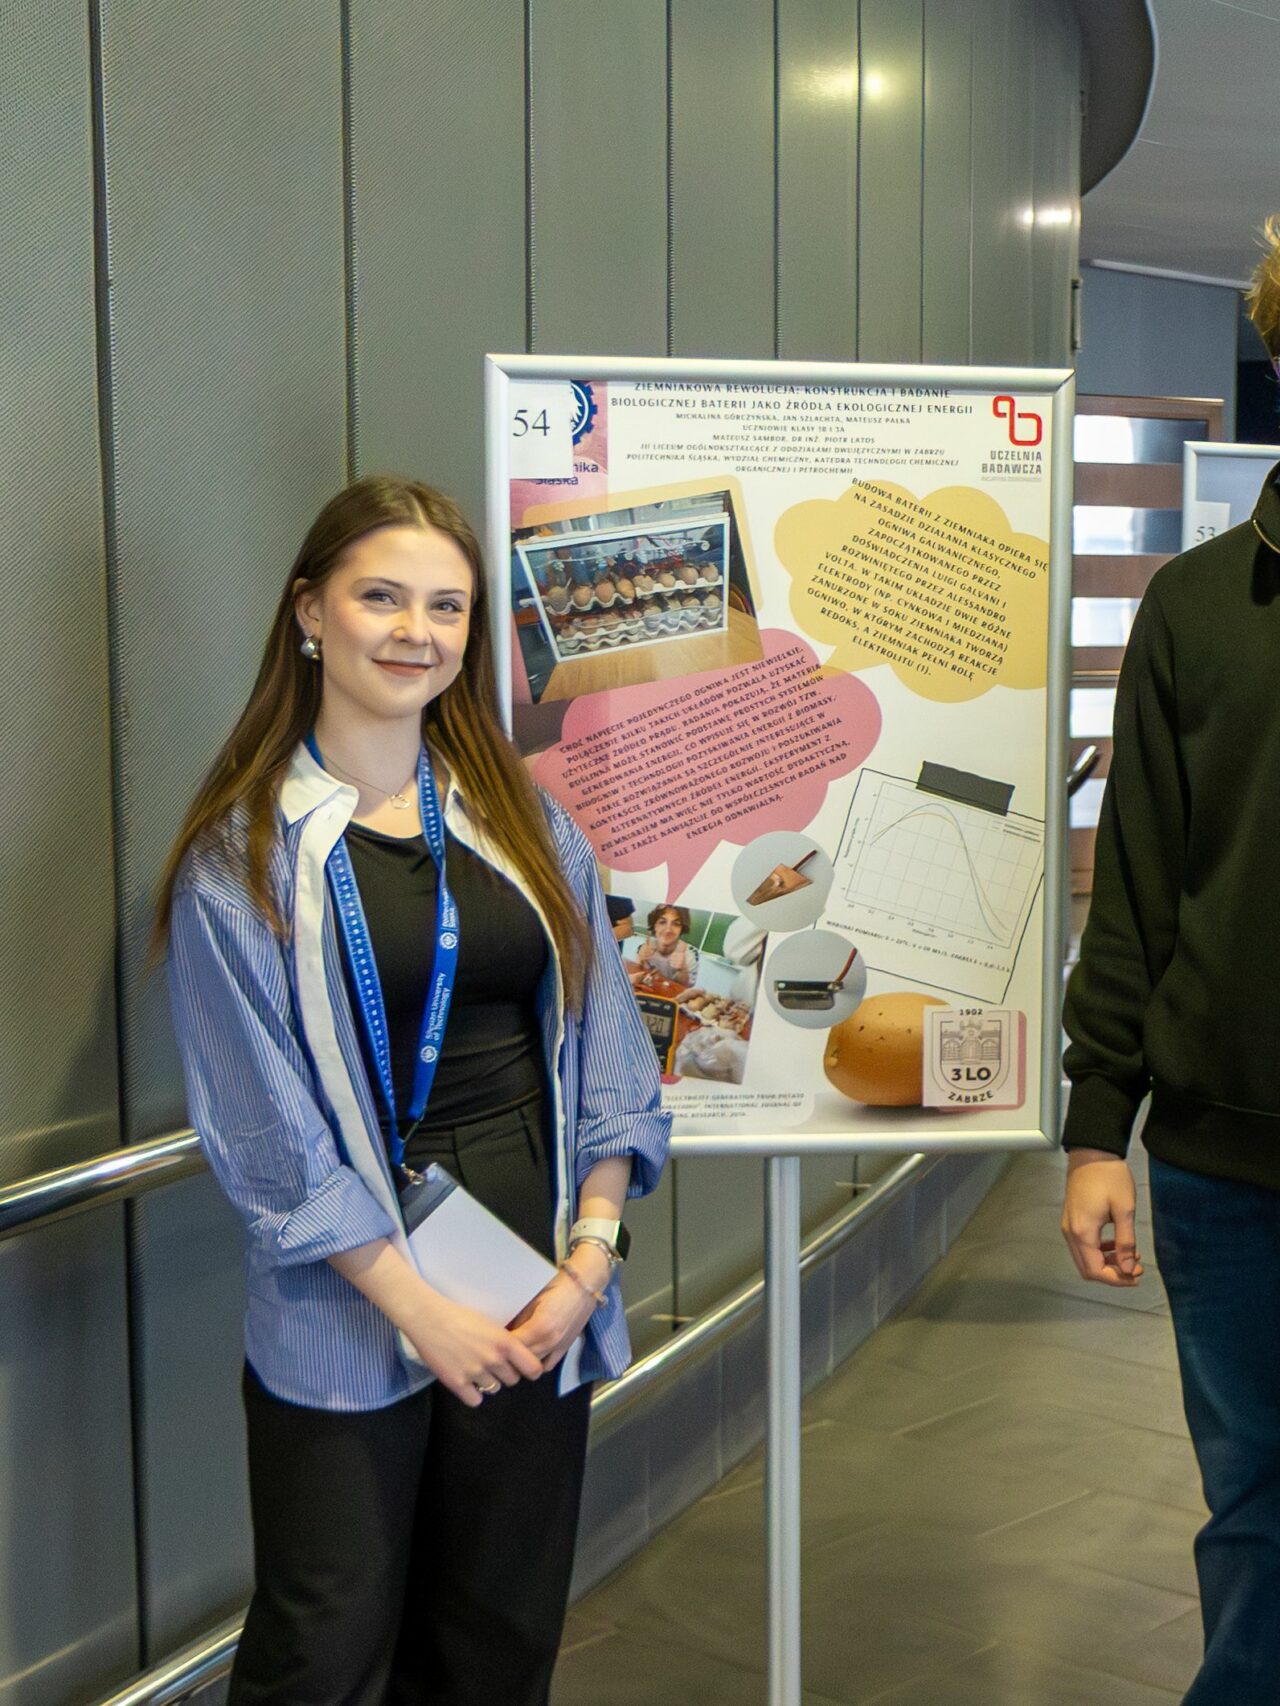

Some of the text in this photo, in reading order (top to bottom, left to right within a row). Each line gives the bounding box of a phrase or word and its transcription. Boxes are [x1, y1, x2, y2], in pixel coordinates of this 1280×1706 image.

[610, 397, 973, 414] BIOLOGICZNEJ BATERII JAKO ŹRÓDŁA EKOLOGICZNEJ ENERGII
[634, 382, 949, 398] ZIEMNIAKOWA REWOLUCJA: KONSTRUKCJA I BADANIE
[512, 408, 551, 438] 54
[652, 442, 683, 450] LICEUM
[780, 445, 831, 453] ODDZIAŁAMI
[834, 447, 901, 455] DWUJĘZYCZNYMI
[762, 456, 811, 464] CHEMICZNY,
[990, 450, 1043, 462] UCZELNIA
[981, 463, 1042, 475] BADAWCZA
[851, 477, 1049, 571] BUDOWA BATERII Z ZIEMNIAKA OPIERA SIĘ
[853, 492, 1037, 579] NA ZASADZIE DZIAŁANIA KLASYCZNEGO
[867, 527, 1001, 592] ZAPOCZĄTKOWANEGO PRZEZ
[876, 517, 1003, 579] OGNIWA GALWANICZNEGO,
[840, 544, 1006, 623] ROZWINIĘTEGO PRZEZ ALESSANDRO
[851, 533, 930, 575] DOŚWIADCZENIA
[931, 570, 958, 587] LUIGI
[959, 582, 1000, 605] GALVANI
[810, 574, 1004, 665] ZANURZONE W SOKU ZIEMNIAKA TWORZĄ
[816, 562, 1008, 652] ELEKTRODY (NP. CYNKOWA I MIEDZIANA)
[860, 567, 871, 577] W
[872, 572, 903, 591] TAKIM
[904, 586, 952, 613] UKŁADZIE
[953, 608, 979, 624] DWIE
[980, 619, 1012, 639] RÓŻNE
[806, 586, 998, 676] OGNIWO, W KTÓRYM ZACHODZĄ REAKCJE
[819, 607, 975, 680] REDOKS, A ZIEMNIAK PEŁNI ROLĘ
[852, 635, 932, 675] ELEKTROLITU (1).
[647, 709, 681, 729] TAKICH
[767, 654, 807, 677] UZYSKAĆ
[693, 676, 729, 696] OGNIWA
[730, 667, 750, 681] JEST
[732, 694, 777, 718] PROSTYCH
[683, 740, 698, 751] CO
[698, 725, 734, 745] WPISUJE
[735, 718, 750, 730] SIĘ
[828, 752, 848, 765] NAD
[715, 784, 744, 801] TYLKO
[431, 971, 447, 1010] University
[959, 1008, 983, 1016] 1902
[951, 1067, 992, 1081] 3 LO
[948, 1090, 994, 1103] ZABRZE
